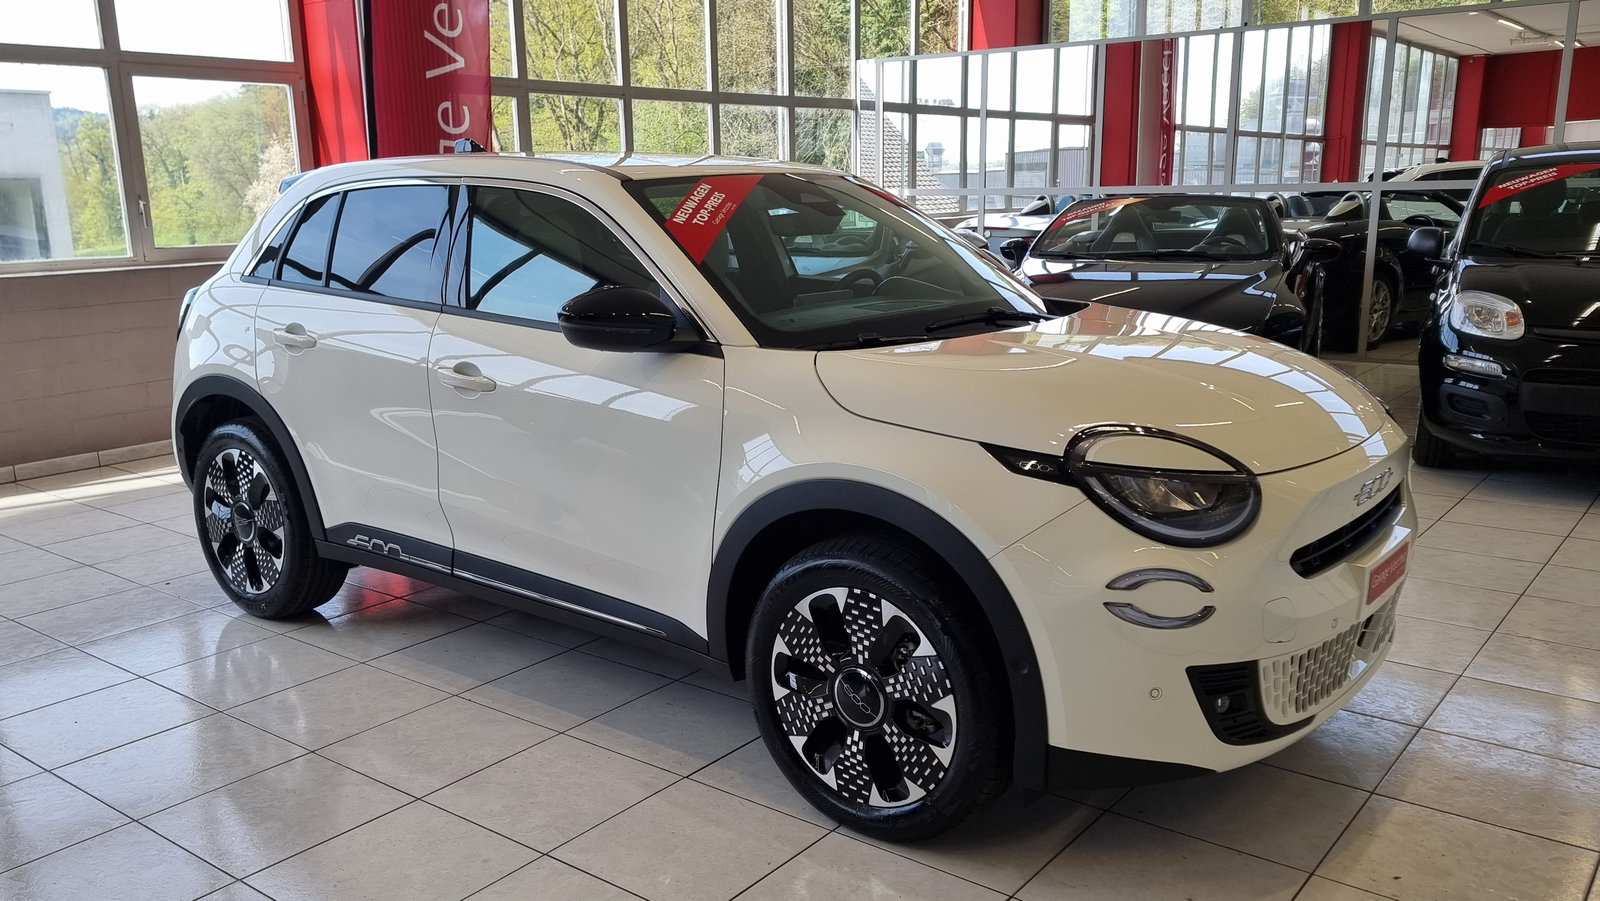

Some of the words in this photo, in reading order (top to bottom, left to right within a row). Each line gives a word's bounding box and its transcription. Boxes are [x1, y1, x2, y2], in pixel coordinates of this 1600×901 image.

[1497, 167, 1558, 189] NEUWAGEN
[1507, 172, 1558, 190] TOP-PREIS
[672, 182, 712, 225] NEUWAGEN
[692, 191, 726, 225] TOP-PREIS
